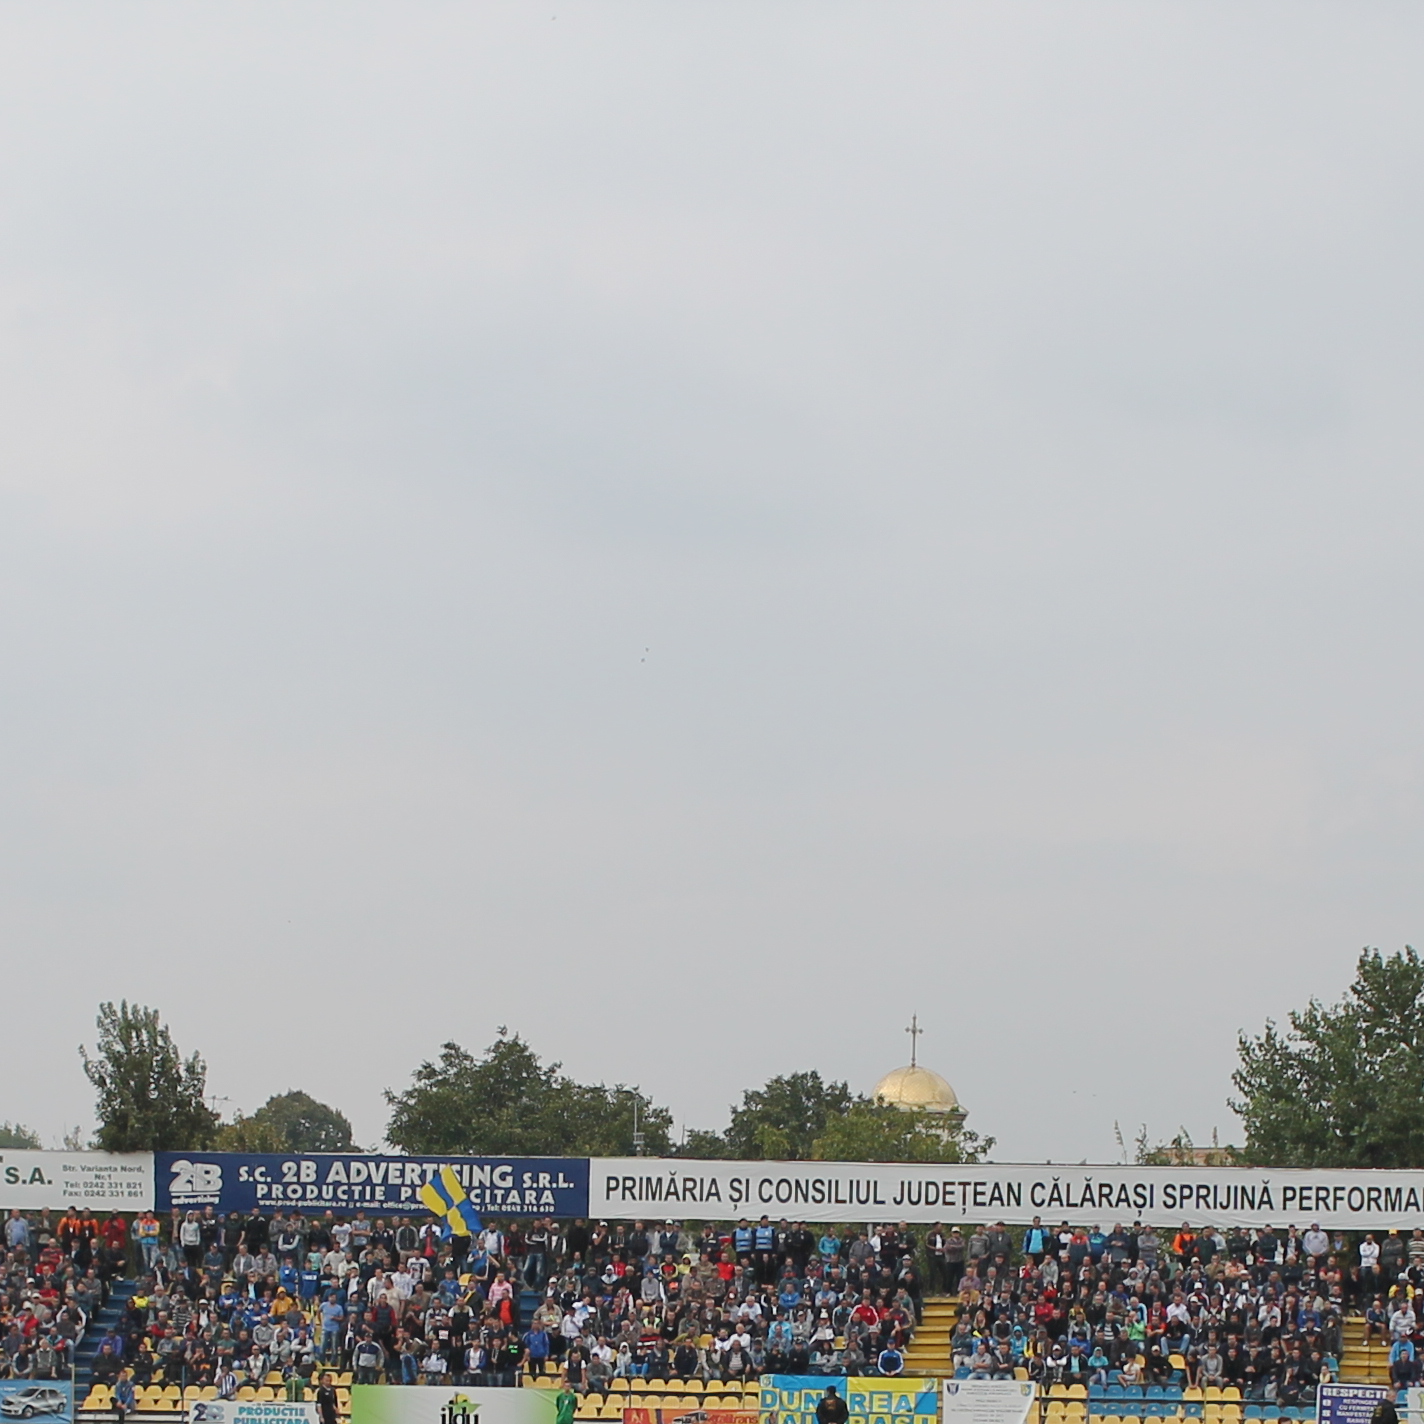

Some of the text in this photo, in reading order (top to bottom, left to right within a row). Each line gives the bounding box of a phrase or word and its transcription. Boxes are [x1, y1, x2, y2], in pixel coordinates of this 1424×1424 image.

[4, 1165, 54, 1185] S.A.
[79, 1164, 118, 1174] Varianta
[238, 1166, 272, 1183] S.C.
[280, 1160, 318, 1184] 2B
[521, 1172, 575, 1189] S.R.L.
[82, 1181, 105, 1189] 0242
[84, 1190, 106, 1198] 0242
[256, 1183, 556, 1205] PRODUCTIE PCITARA
[605, 1169, 723, 1203] PRIMĂRIA
[728, 1177, 750, 1212] ȘI
[757, 1178, 887, 1206] CONSILIUL
[892, 1180, 1022, 1215] JUDEȚEAN
[1030, 1176, 1155, 1217] CĂLĂRAȘI
[1162, 1179, 1275, 1211] SPRIJINĂ
[237, 1406, 306, 1417] PRODUCTIE
[761, 1391, 914, 1413] DUNREA
